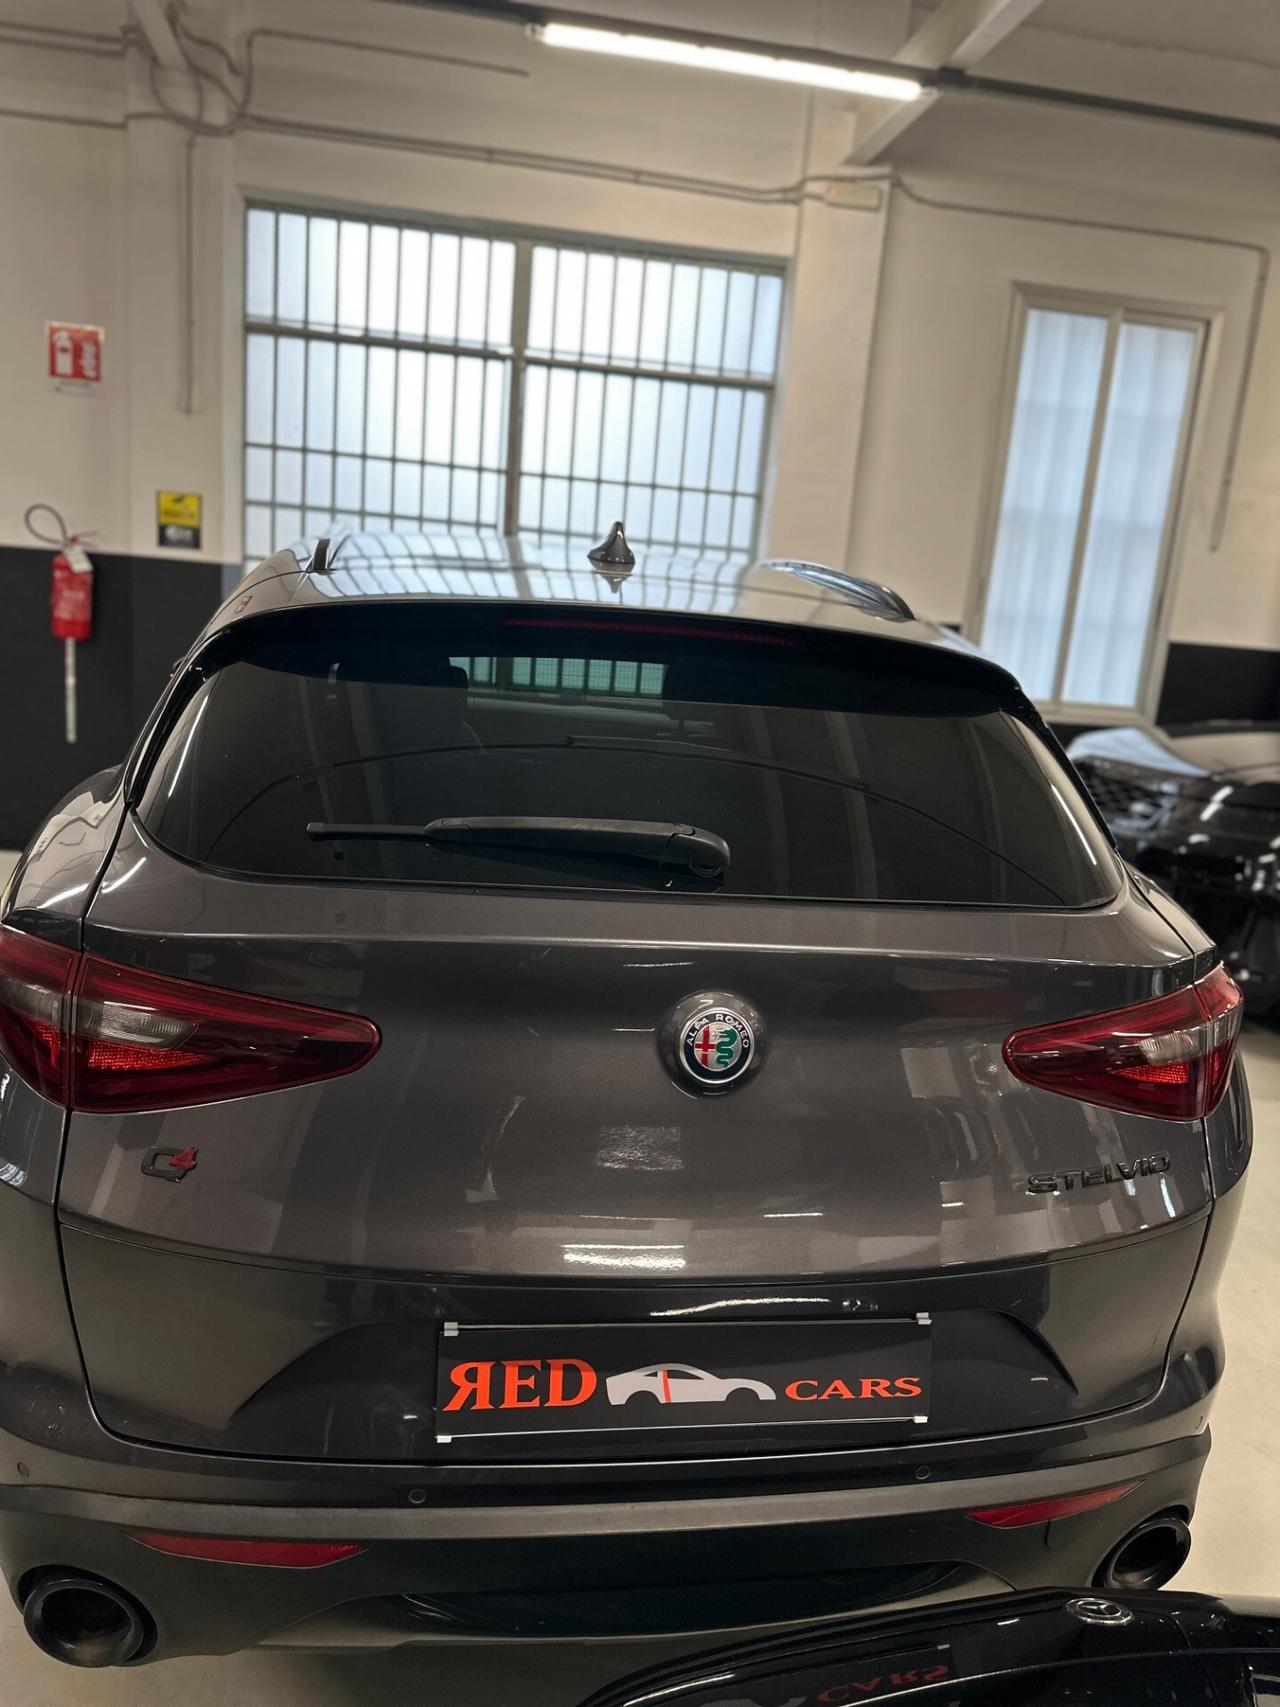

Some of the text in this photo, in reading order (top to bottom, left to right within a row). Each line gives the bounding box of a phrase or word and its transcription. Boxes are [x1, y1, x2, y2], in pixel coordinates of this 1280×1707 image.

[687, 1013, 750, 1048] ALFA ROMEO
[142, 1146, 199, 1183] Q4
[1027, 1153, 1171, 1193] STELVIO
[784, 1376, 923, 1400] CARS
